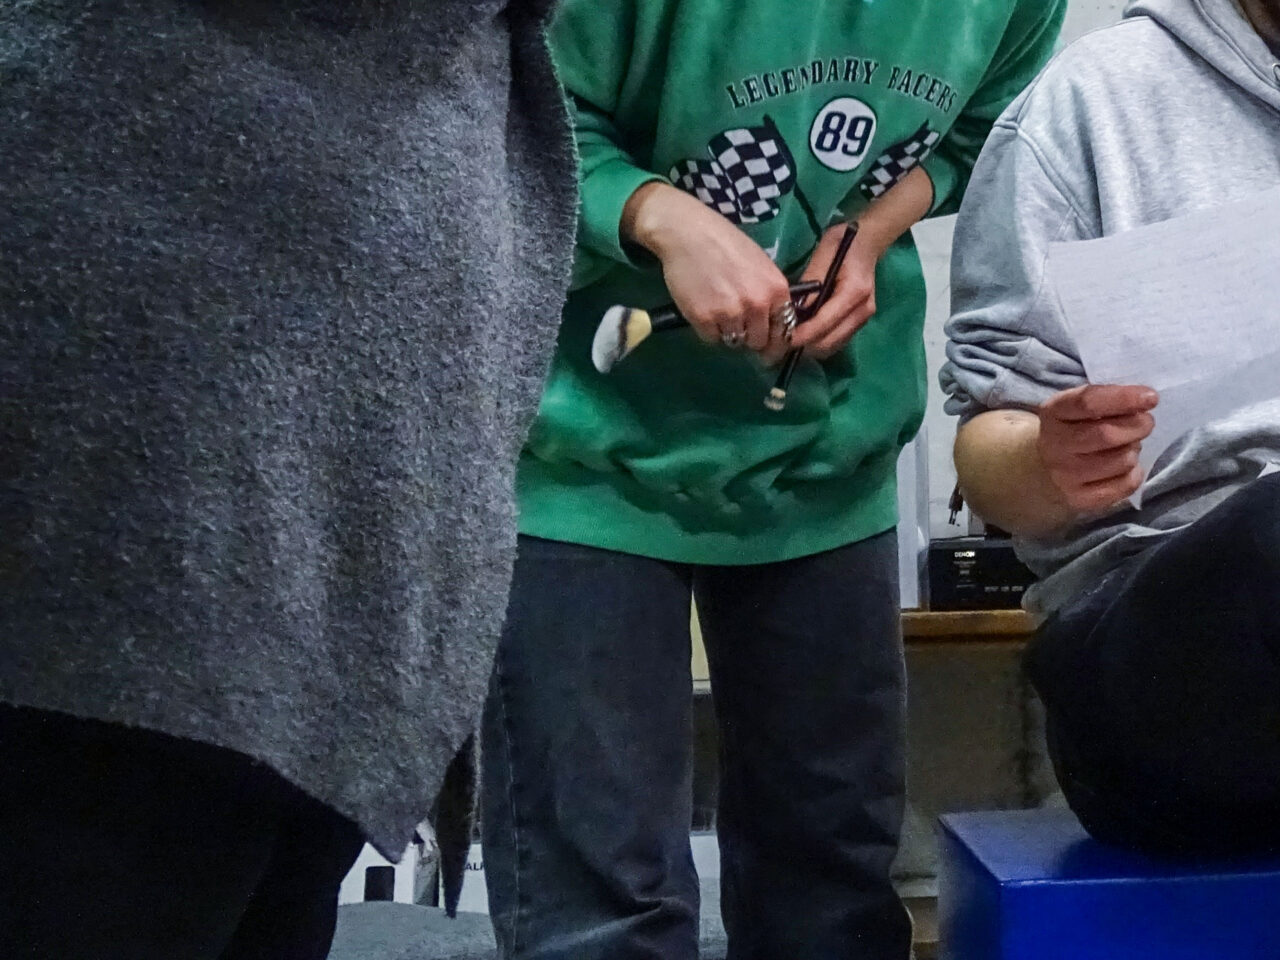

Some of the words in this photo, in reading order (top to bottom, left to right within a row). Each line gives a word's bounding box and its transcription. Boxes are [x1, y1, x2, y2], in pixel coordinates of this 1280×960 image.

[726, 58, 879, 109] LEGENDARY
[887, 66, 958, 113] RACERS
[814, 111, 874, 156] 89
